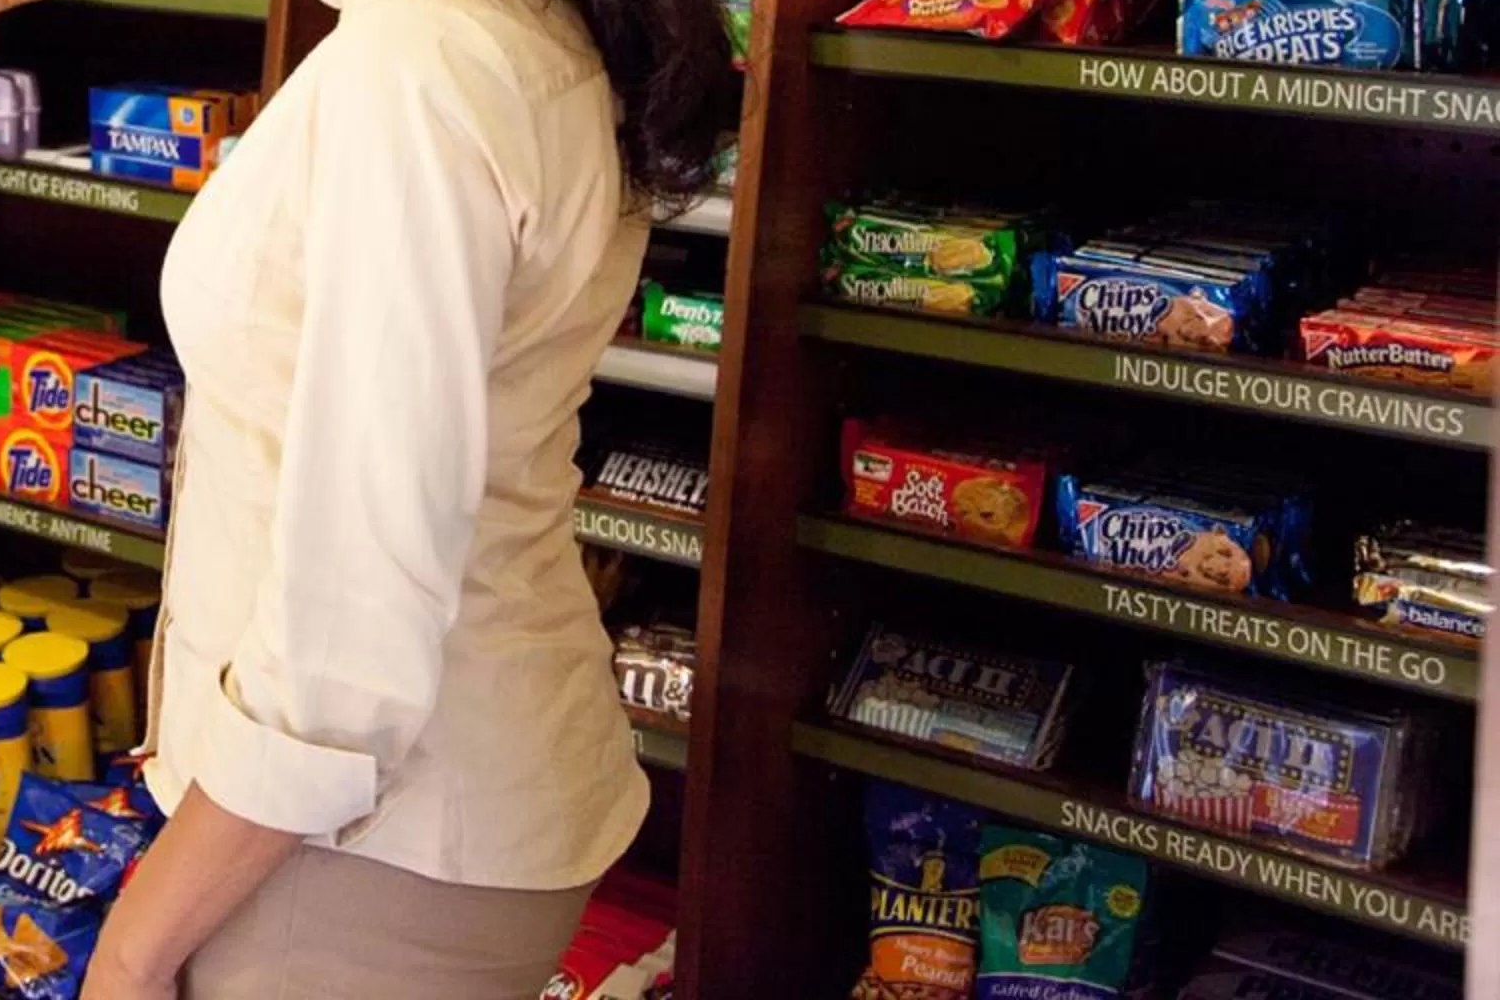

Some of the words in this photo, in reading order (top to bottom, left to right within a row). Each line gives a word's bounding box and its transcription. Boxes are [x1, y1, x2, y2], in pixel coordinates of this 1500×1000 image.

[1215, 21, 1257, 59] RICE
[1259, 7, 1357, 41] KRISPIES
[1080, 60, 1145, 89] HOW
[1152, 68, 1244, 98] ABOUT
[1251, 76, 1270, 100] A
[1277, 78, 1427, 117] MIDNIGHT
[1432, 91, 1500, 124] SNA
[108, 129, 180, 160] TAMPAX
[50, 176, 139, 211] EVERYTHING
[1080, 283, 1152, 312] Chips
[29, 369, 69, 413] Tide
[76, 382, 160, 440] cheer
[1116, 354, 1229, 398] INDULGE
[1235, 375, 1311, 411] YOUR
[1317, 389, 1464, 436] CRAVINGS
[8, 448, 52, 493] Tide
[72, 458, 157, 515] cheer
[598, 451, 708, 504] HERSHEY
[50, 516, 111, 552] ANYTIME
[574, 509, 656, 549] ELICIOUS
[660, 529, 703, 561] SNA
[1102, 512, 1180, 541] Chips
[1102, 585, 1181, 624] TASTY
[1185, 603, 1280, 648] TREATS
[1287, 628, 1330, 660] ON
[1336, 636, 1392, 674] THE
[1400, 653, 1445, 685] GO
[1061, 801, 1158, 851] SNACKS
[1166, 831, 1252, 877] READY
[1258, 857, 1343, 905] WHEN
[1349, 883, 1411, 924] YOU
[1417, 905, 1474, 944] ARE
